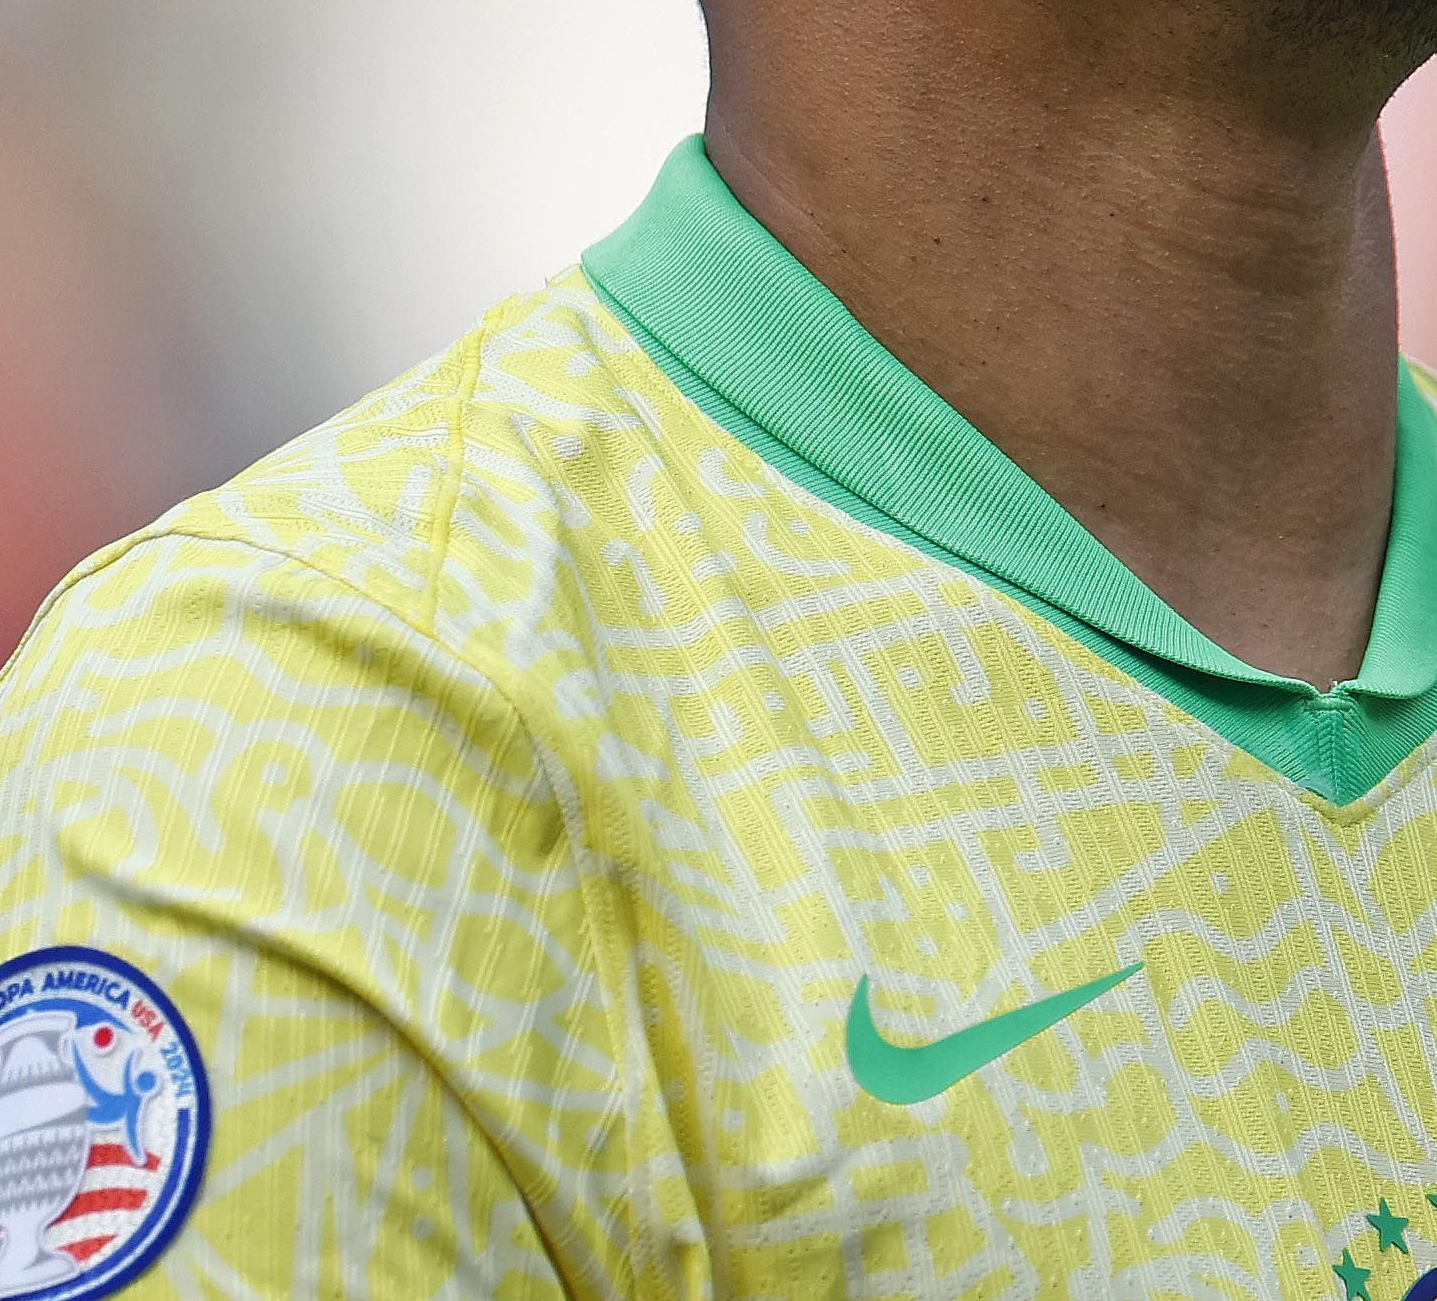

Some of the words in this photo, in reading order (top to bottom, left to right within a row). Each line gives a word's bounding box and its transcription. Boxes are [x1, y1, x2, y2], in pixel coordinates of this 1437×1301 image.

[41, 970, 131, 1010] AMERICA
[131, 999, 164, 1041] USA
[160, 1042, 192, 1098] 2024
